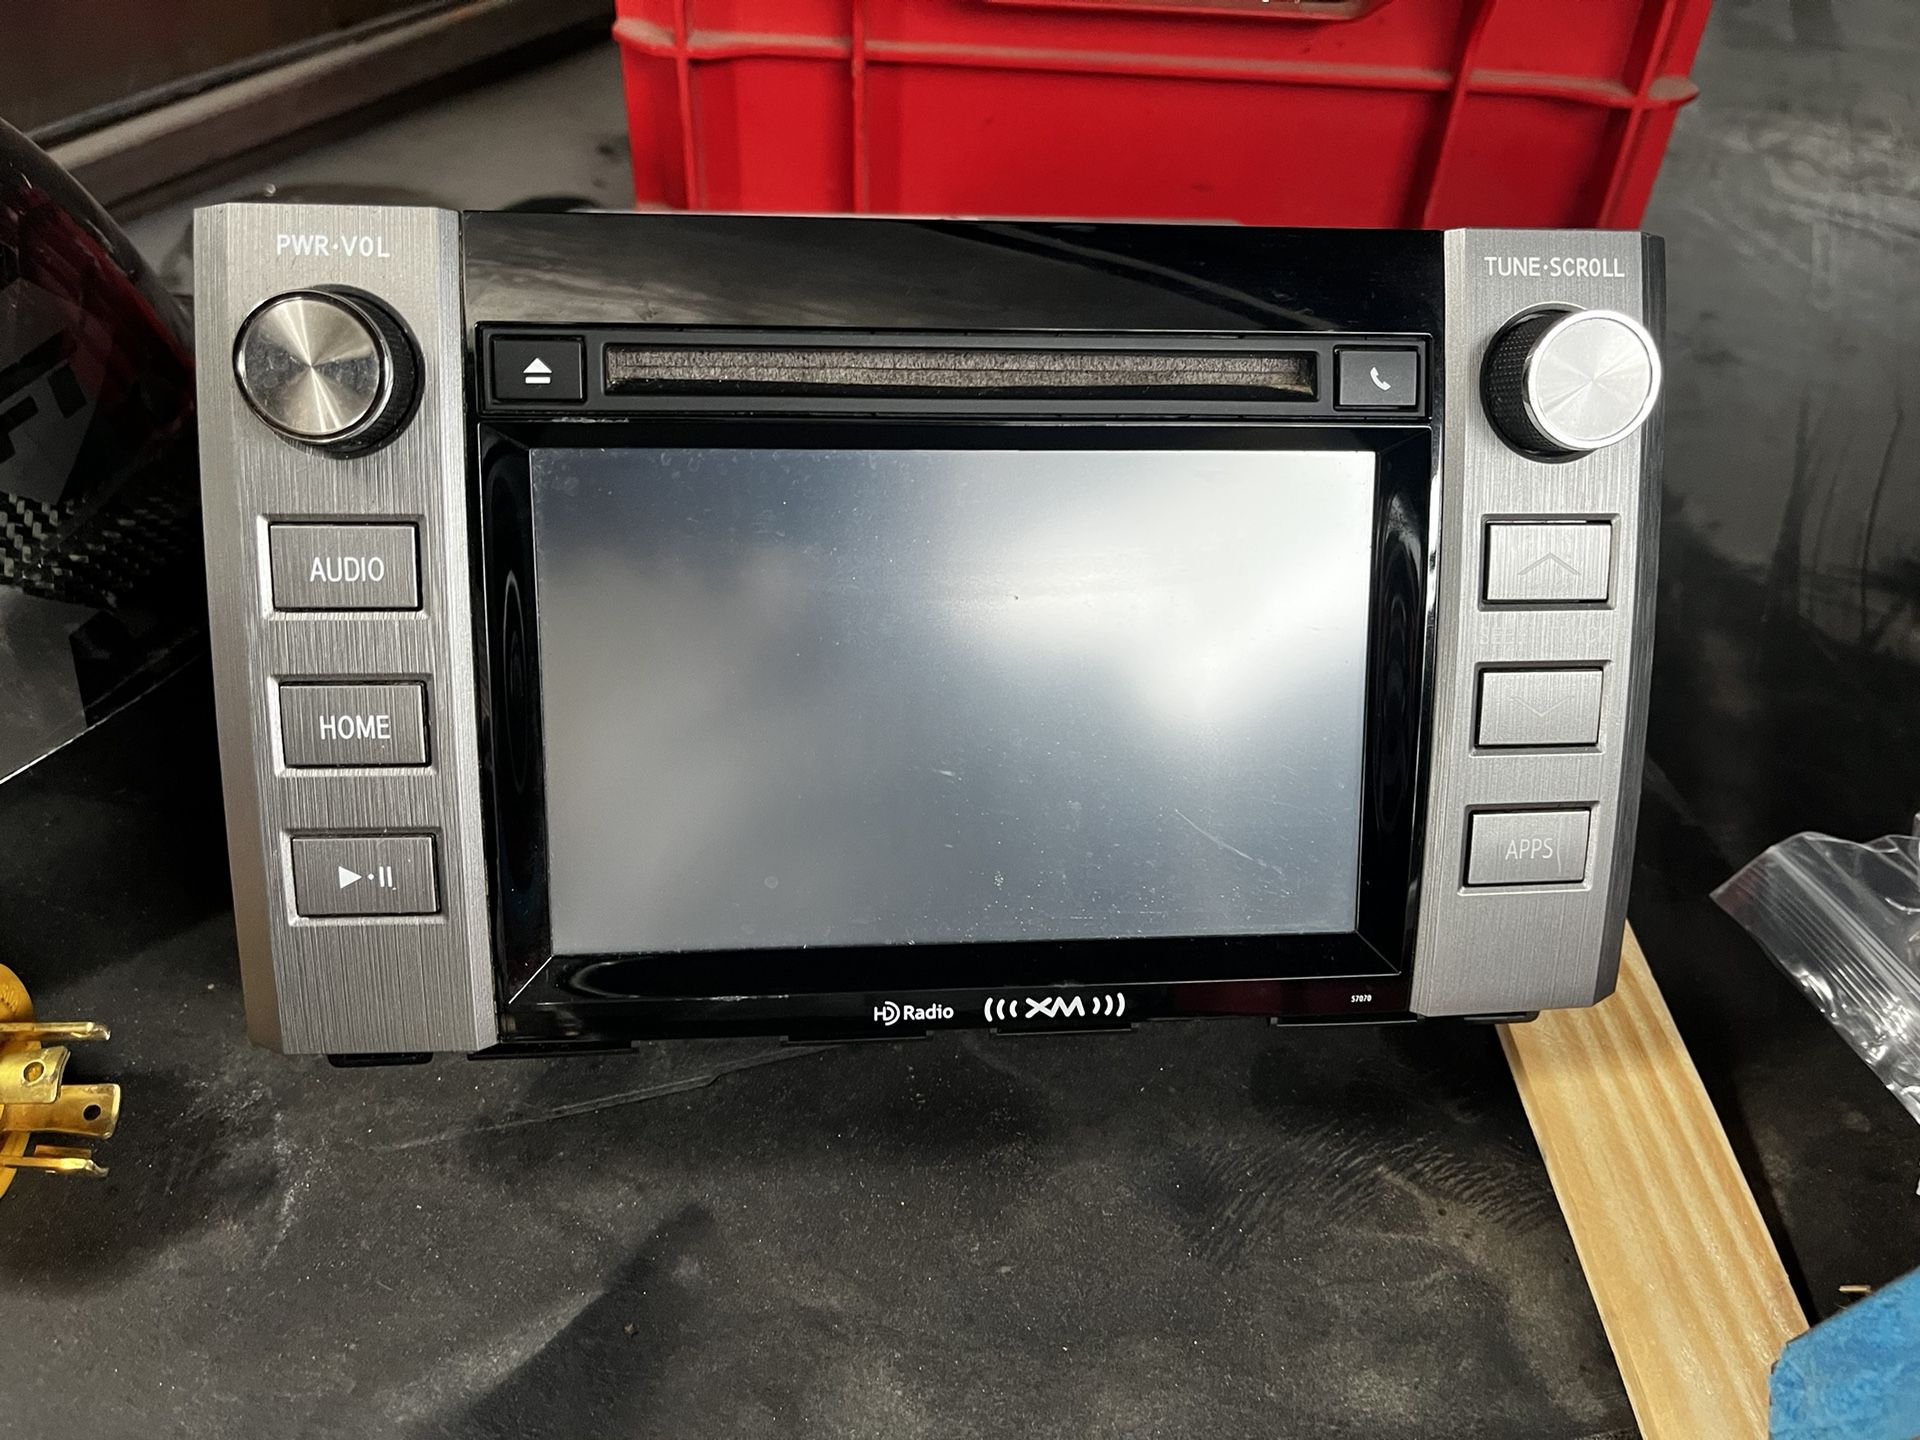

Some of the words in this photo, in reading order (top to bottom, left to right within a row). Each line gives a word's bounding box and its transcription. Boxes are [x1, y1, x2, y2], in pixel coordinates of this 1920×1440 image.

[309, 556, 385, 582] AUDIO
[1479, 626, 1530, 645] SEE
[319, 714, 392, 740] HOME
[1504, 837, 1554, 860] APPS
[902, 1003, 955, 1021] Radio
